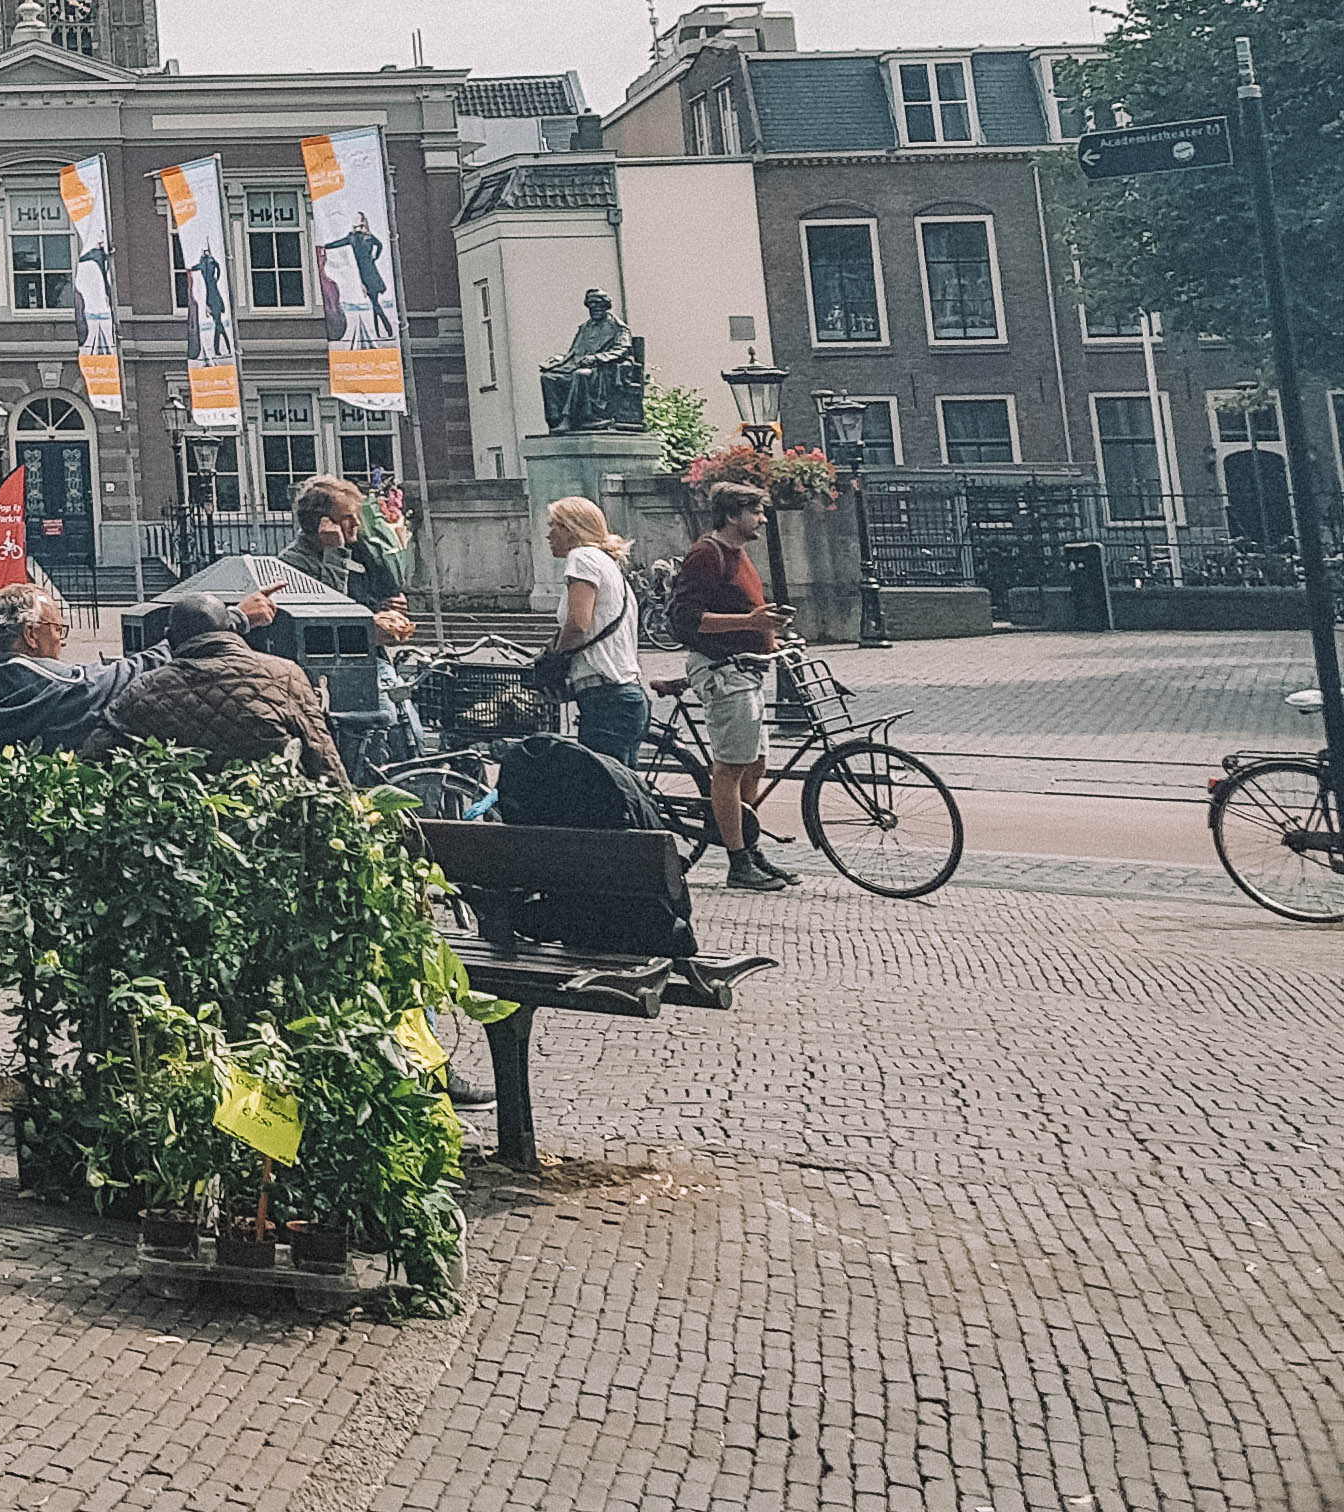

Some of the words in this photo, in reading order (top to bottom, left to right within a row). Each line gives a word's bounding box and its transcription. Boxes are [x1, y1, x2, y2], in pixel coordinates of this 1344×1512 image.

[1100, 128, 1203, 148] Academietheater
[17, 207, 60, 221] HKU
[250, 207, 293, 222] HKU
[264, 408, 308, 422] HKU
[341, 408, 386, 422] HKU
